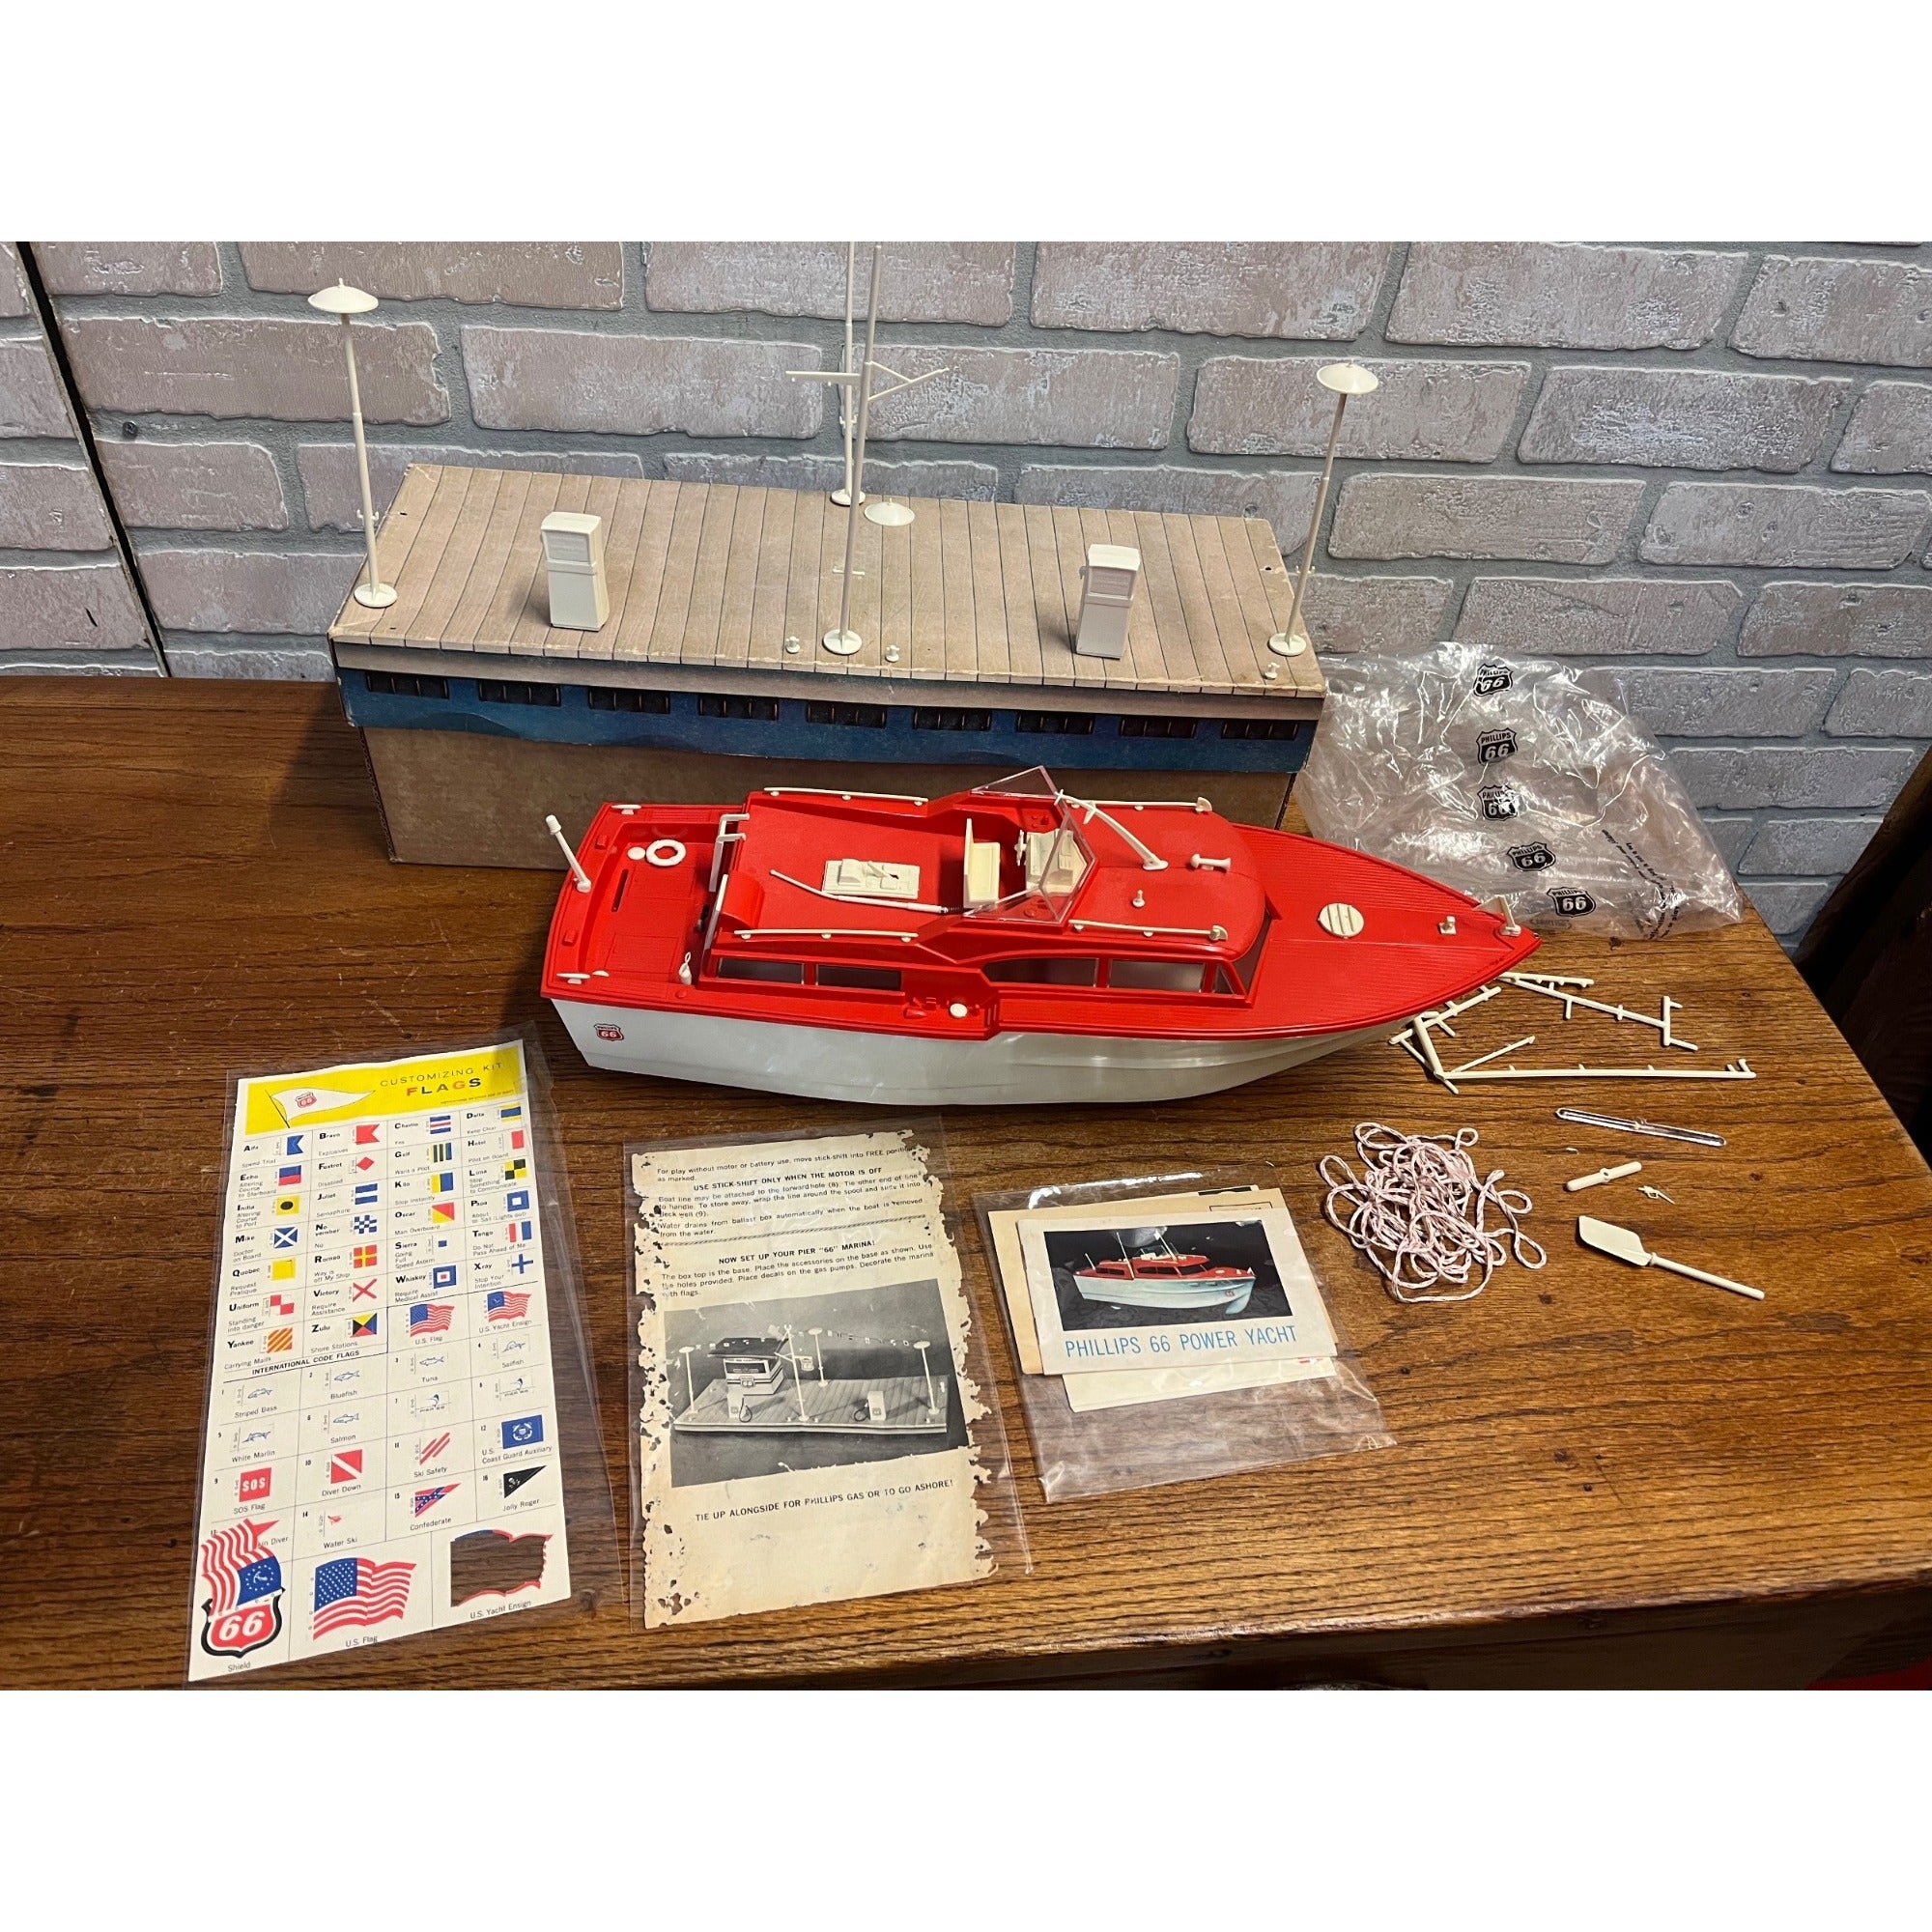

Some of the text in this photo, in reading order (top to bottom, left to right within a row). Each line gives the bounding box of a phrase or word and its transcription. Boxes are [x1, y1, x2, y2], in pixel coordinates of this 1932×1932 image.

[1480, 676, 1505, 692] 66
[1481, 732, 1512, 744] PHILLIPS
[1485, 743, 1510, 760] 66
[1512, 844, 1542, 856] PHILLIPS
[1520, 852, 1546, 867] 66
[1562, 896, 1587, 911] 66
[380, 1063, 502, 1087] CUSTOMIZING KIT
[407, 1078, 481, 1096] FLAGS
[712, 1179, 757, 1188] STICK-SHIFT
[235, 1236, 255, 1244] Mike
[841, 1240, 875, 1251] MARINA!
[315, 1255, 341, 1264] Romeo
[791, 1258, 834, 1266] accessories
[860, 1259, 892, 1267] Decorate
[313, 1289, 340, 1297] Victory
[229, 1302, 260, 1311] Uniform
[311, 1324, 330, 1333] Zulu
[227, 1340, 254, 1349] Yankee
[1065, 1324, 1296, 1357] PHILLIPS 66 POWER YACHT
[252, 1350, 360, 1376] INTERNATIONAL CODE FLAGS
[330, 1389, 357, 1400] Bluefish
[234, 1405, 278, 1419] Striped Bass
[330, 1434, 356, 1444] Salmon
[232, 1450, 275, 1463] White Marlin
[482, 1445, 553, 1463] Coast Guard Auxiliary
[426, 1466, 447, 1477] Safety
[242, 1477, 267, 1492] SOS
[322, 1484, 361, 1497] Diver Down
[503, 1498, 540, 1512] Jolly Roger
[696, 1479, 953, 1521] TIE UP ALONGSIDE FOR PHILLIPS GAS OR TO GO ASHORE!
[233, 1502, 266, 1515] SOS Flag
[410, 1517, 452, 1531] Confederate
[271, 1536, 289, 1545] Diver
[324, 1540, 344, 1549] Water
[469, 1600, 531, 1620] U.S. Yacht Ensign
[218, 1610, 266, 1641] 66
[346, 1634, 378, 1648] U.S. Flag
[227, 1661, 251, 1673] Shield
